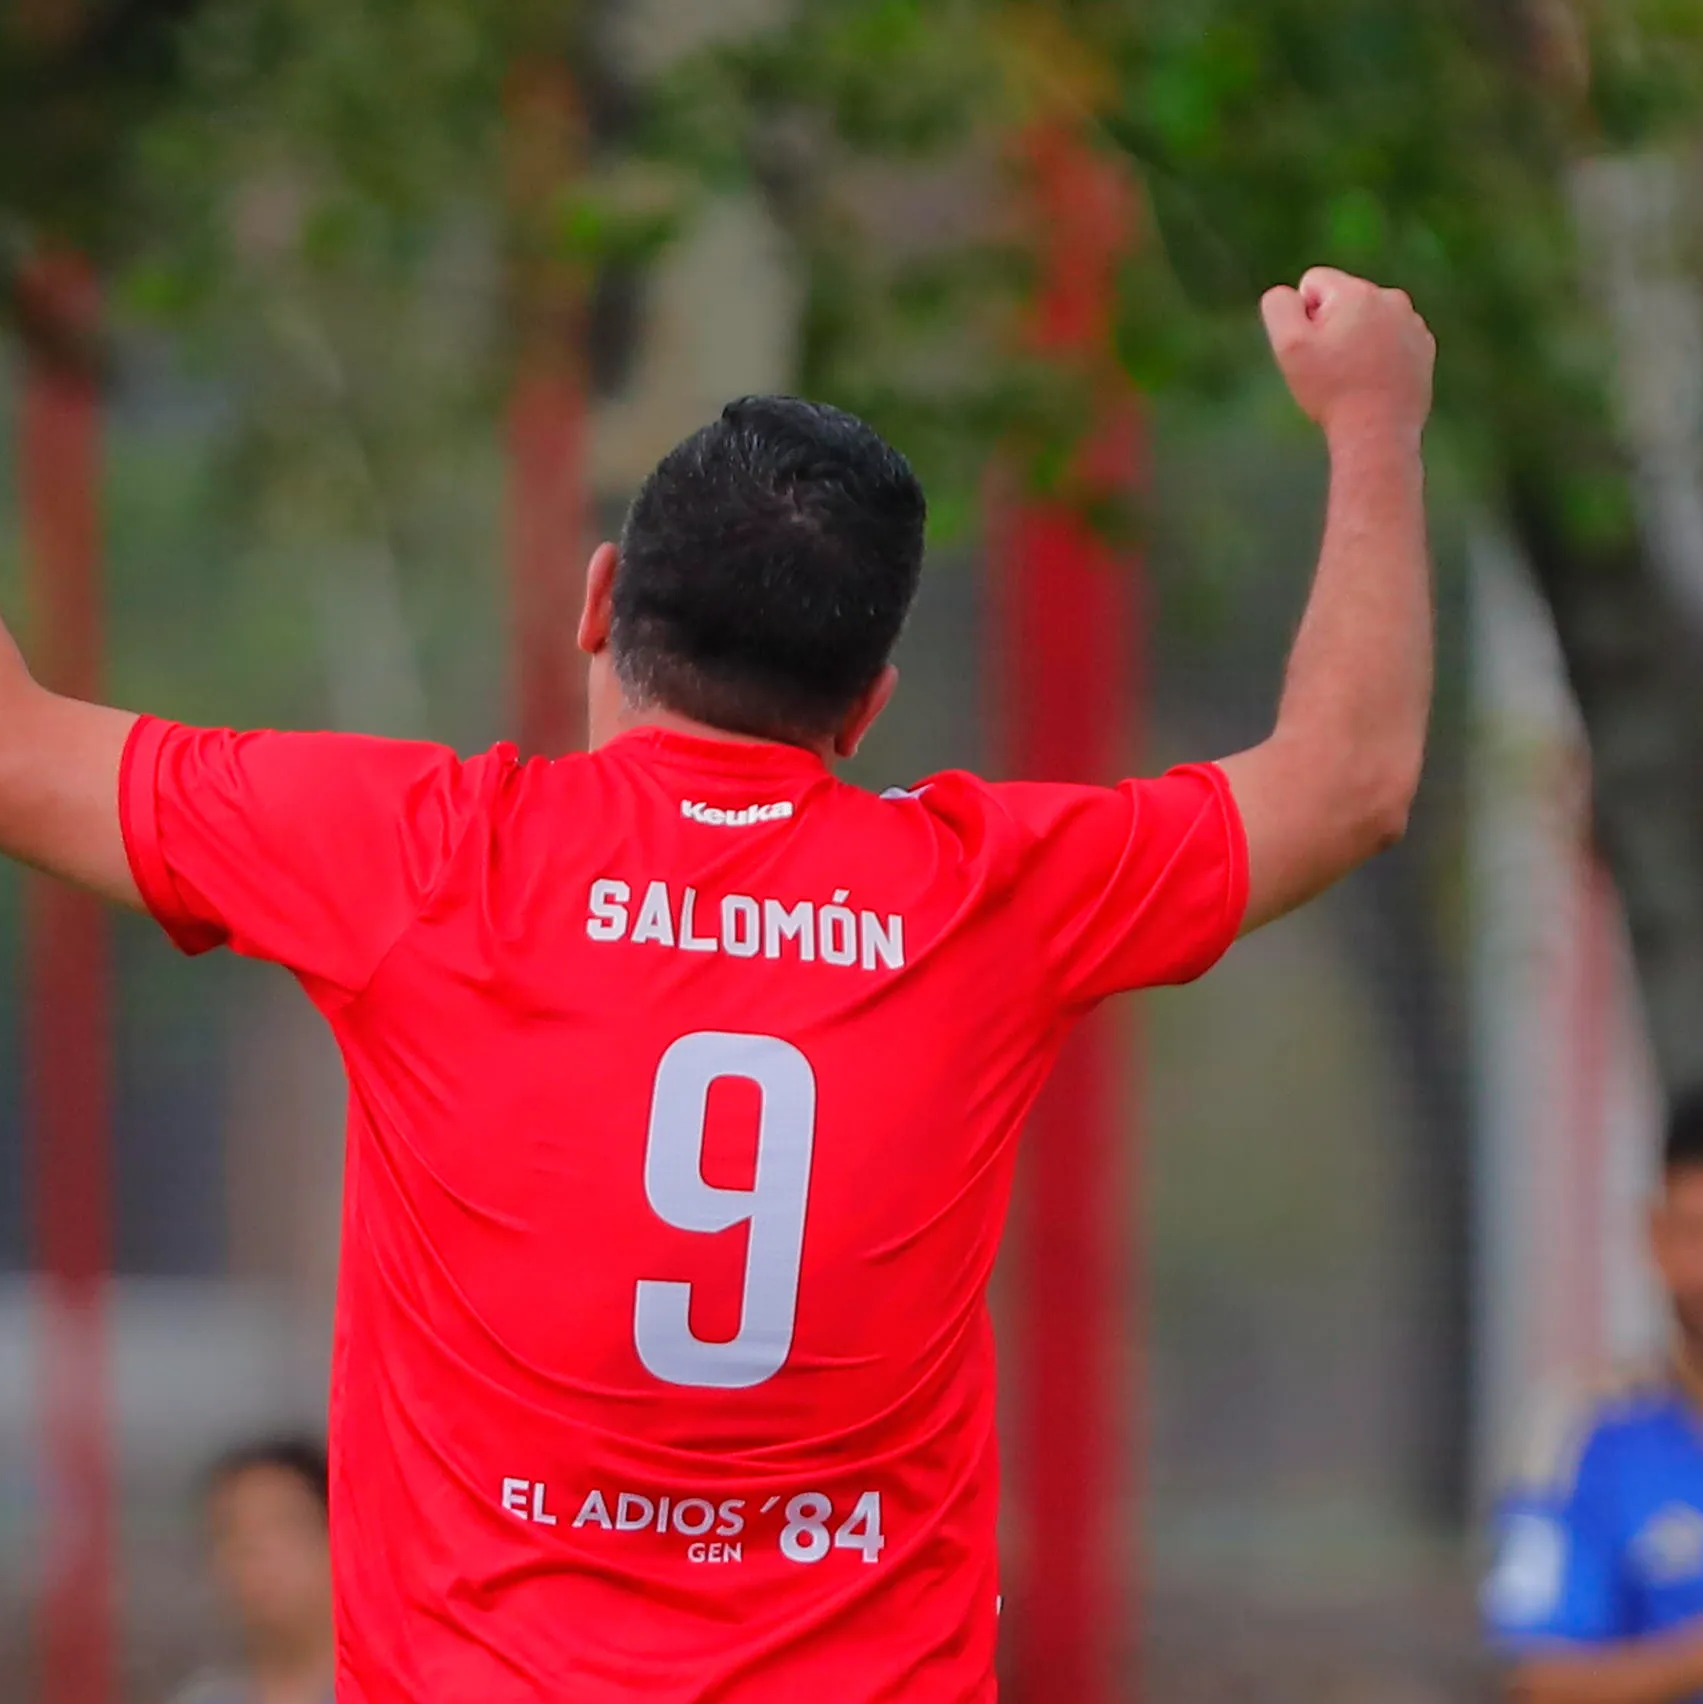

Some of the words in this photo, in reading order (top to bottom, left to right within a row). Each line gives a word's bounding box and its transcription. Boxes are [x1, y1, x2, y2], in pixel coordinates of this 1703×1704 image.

[680, 799, 794, 827] Keuka
[585, 878, 905, 971] SALOMÓN
[633, 1031, 816, 1389] 9
[501, 1477, 557, 1526] EL
[571, 1489, 745, 1535] ADIOS
[687, 1542, 742, 1563] GEN
